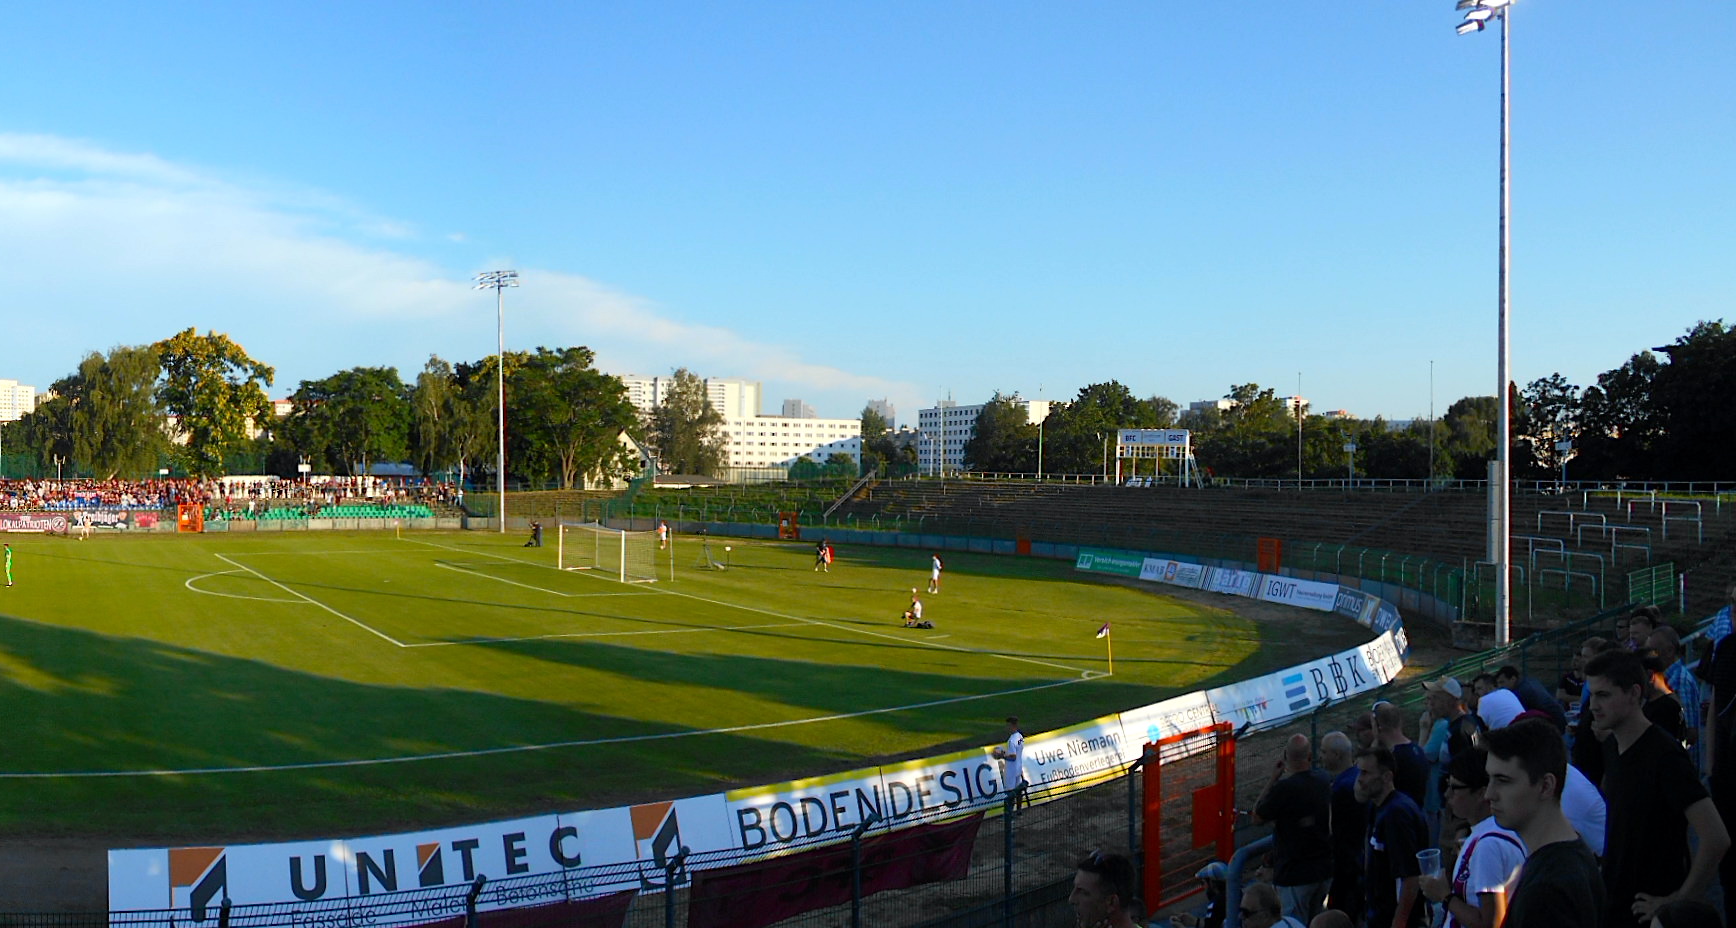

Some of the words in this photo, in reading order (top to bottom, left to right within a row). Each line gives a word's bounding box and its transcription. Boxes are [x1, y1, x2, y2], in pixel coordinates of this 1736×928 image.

[1125, 434, 1137, 442] BFC
[1167, 434, 1184, 442] GAST
[0, 519, 52, 530] LOKALPATRIOTEN
[1267, 580, 1297, 599] IGWT
[1336, 590, 1363, 613] primus
[1310, 655, 1366, 701] BBK
[1035, 750, 1063, 766] Uwe
[1067, 731, 1121, 758] Niemann
[1040, 750, 1126, 784] Fußbodenverlegerei
[737, 761, 1006, 850] BODENDESIG
[289, 826, 582, 901] UNITEC
